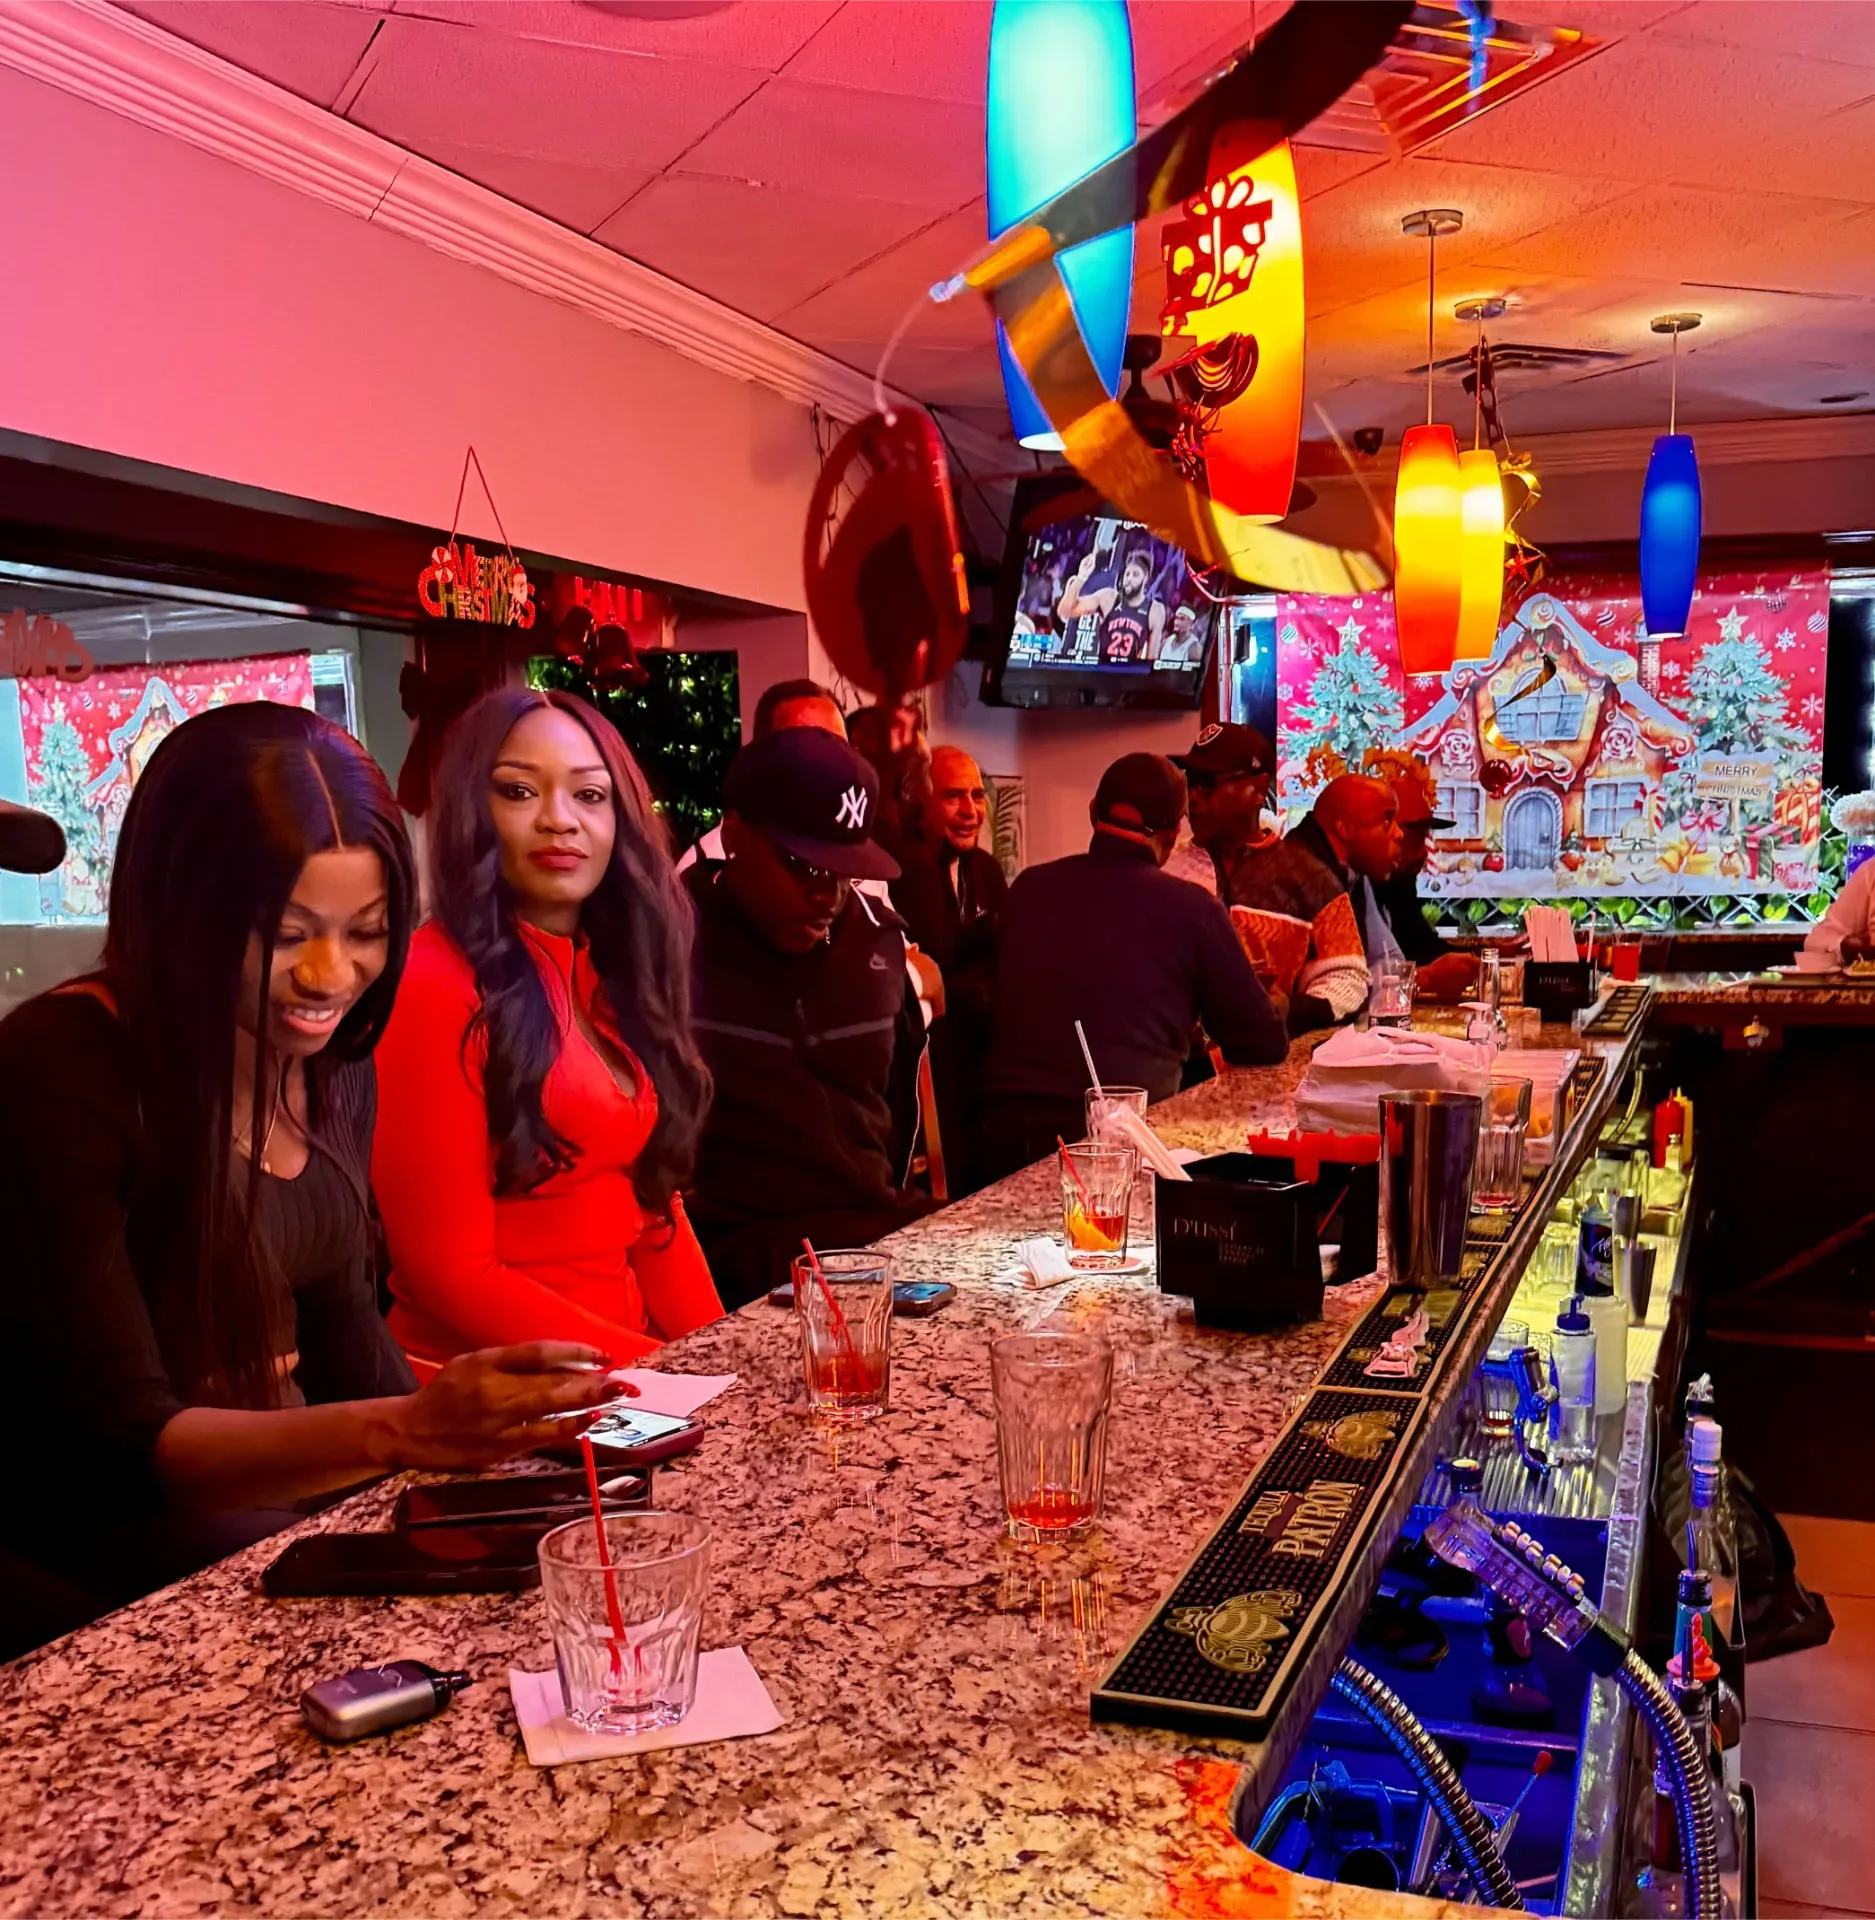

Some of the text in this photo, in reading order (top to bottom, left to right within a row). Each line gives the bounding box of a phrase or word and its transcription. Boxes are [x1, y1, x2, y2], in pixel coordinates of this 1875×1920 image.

[1074, 629, 1097, 651] THE
[1107, 631, 1134, 657] 23
[1714, 764, 1758, 777] MERRY
[1704, 783, 1763, 797] CHRISTMAS
[835, 785, 868, 829] NY
